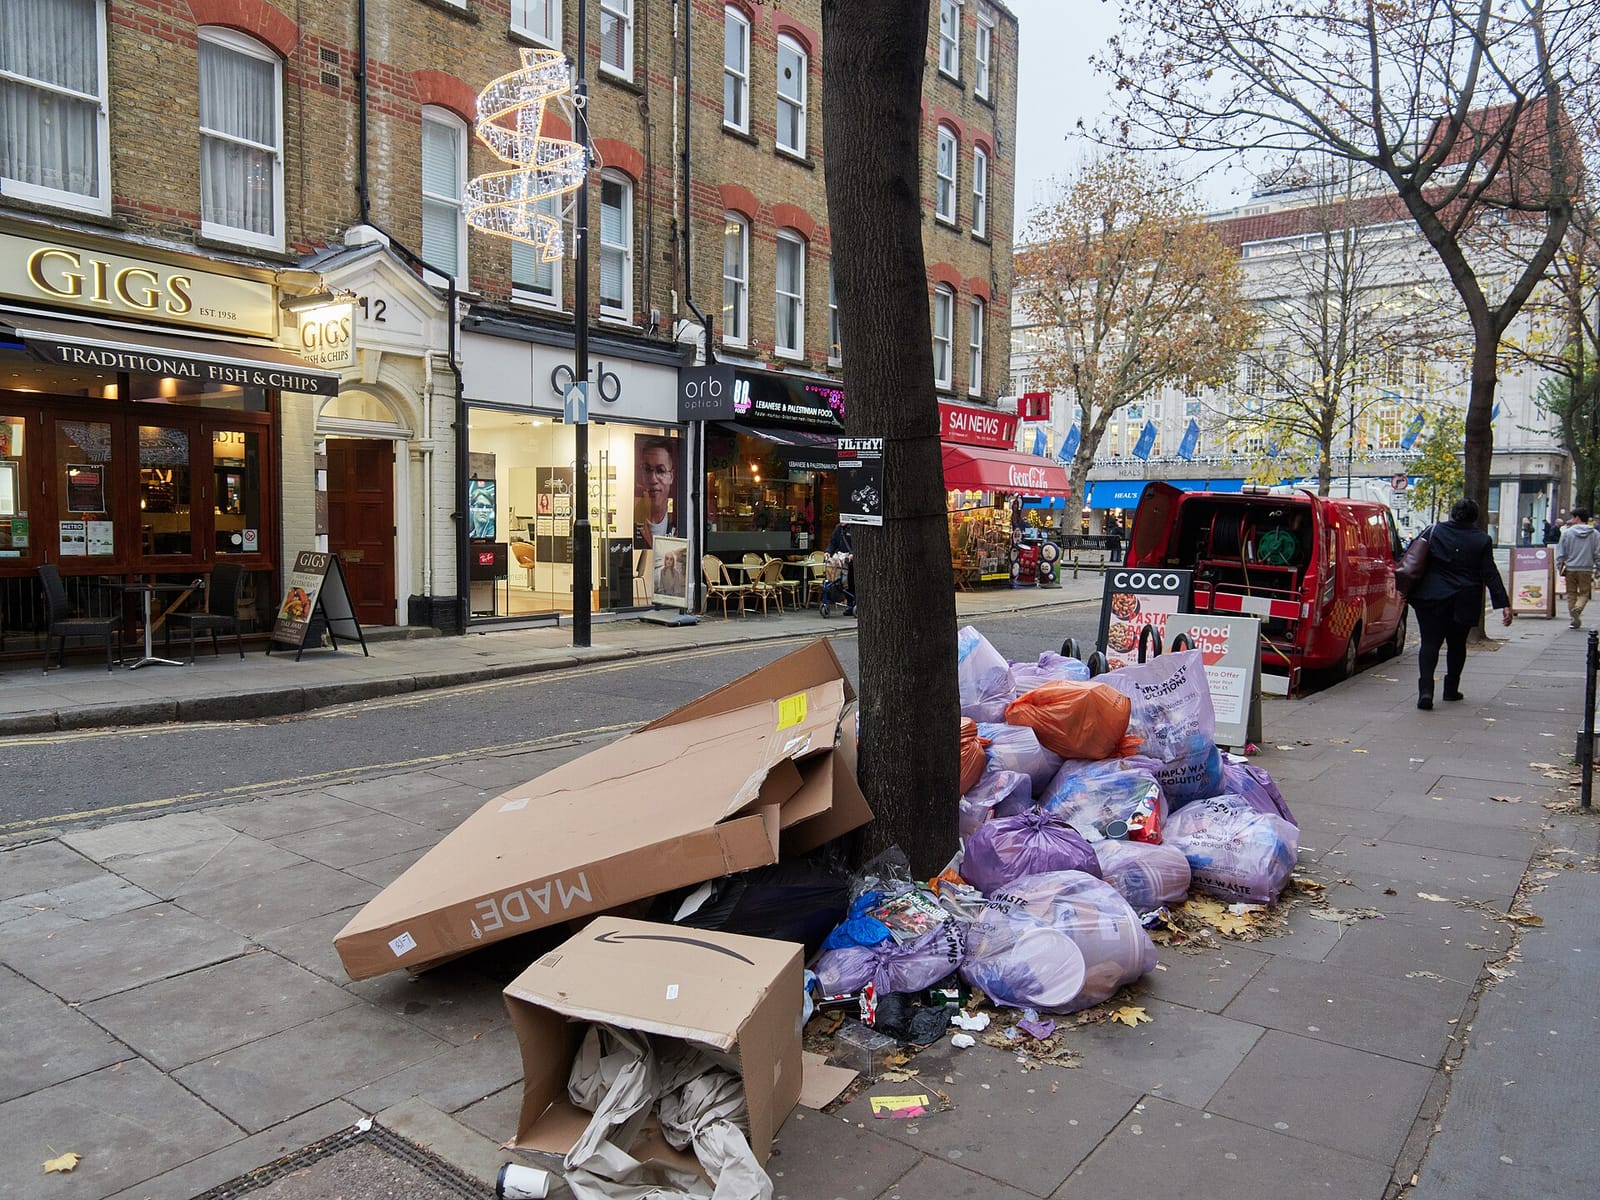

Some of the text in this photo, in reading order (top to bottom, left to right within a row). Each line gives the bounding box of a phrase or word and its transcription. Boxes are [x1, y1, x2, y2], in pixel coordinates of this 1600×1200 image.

[27, 247, 193, 316] GIGS
[362, 297, 387, 322] 12
[301, 317, 351, 349] GIGS
[327, 350, 349, 363] CHIPS
[56, 345, 319, 392] TRADITIONAL FISH & CHIPS
[551, 361, 621, 403] ob
[685, 375, 723, 398] orb
[684, 399, 723, 409] optical
[755, 400, 781, 412] LEBANESE
[787, 405, 817, 416] PALESTINIAN
[817, 408, 833, 418] FOOD
[949, 411, 999, 435] SAI NEWS
[837, 438, 883, 450] FILTHY!
[300, 553, 327, 568] GIGS
[1113, 572, 1180, 591] COCO
[1128, 610, 1167, 625] PASTA
[1190, 623, 1231, 640] good
[1220, 671, 1240, 679] Offer
[1143, 676, 1187, 701] OLUTIONS
[1215, 878, 1252, 896] WASTE
[995, 893, 1029, 910] WASTE
